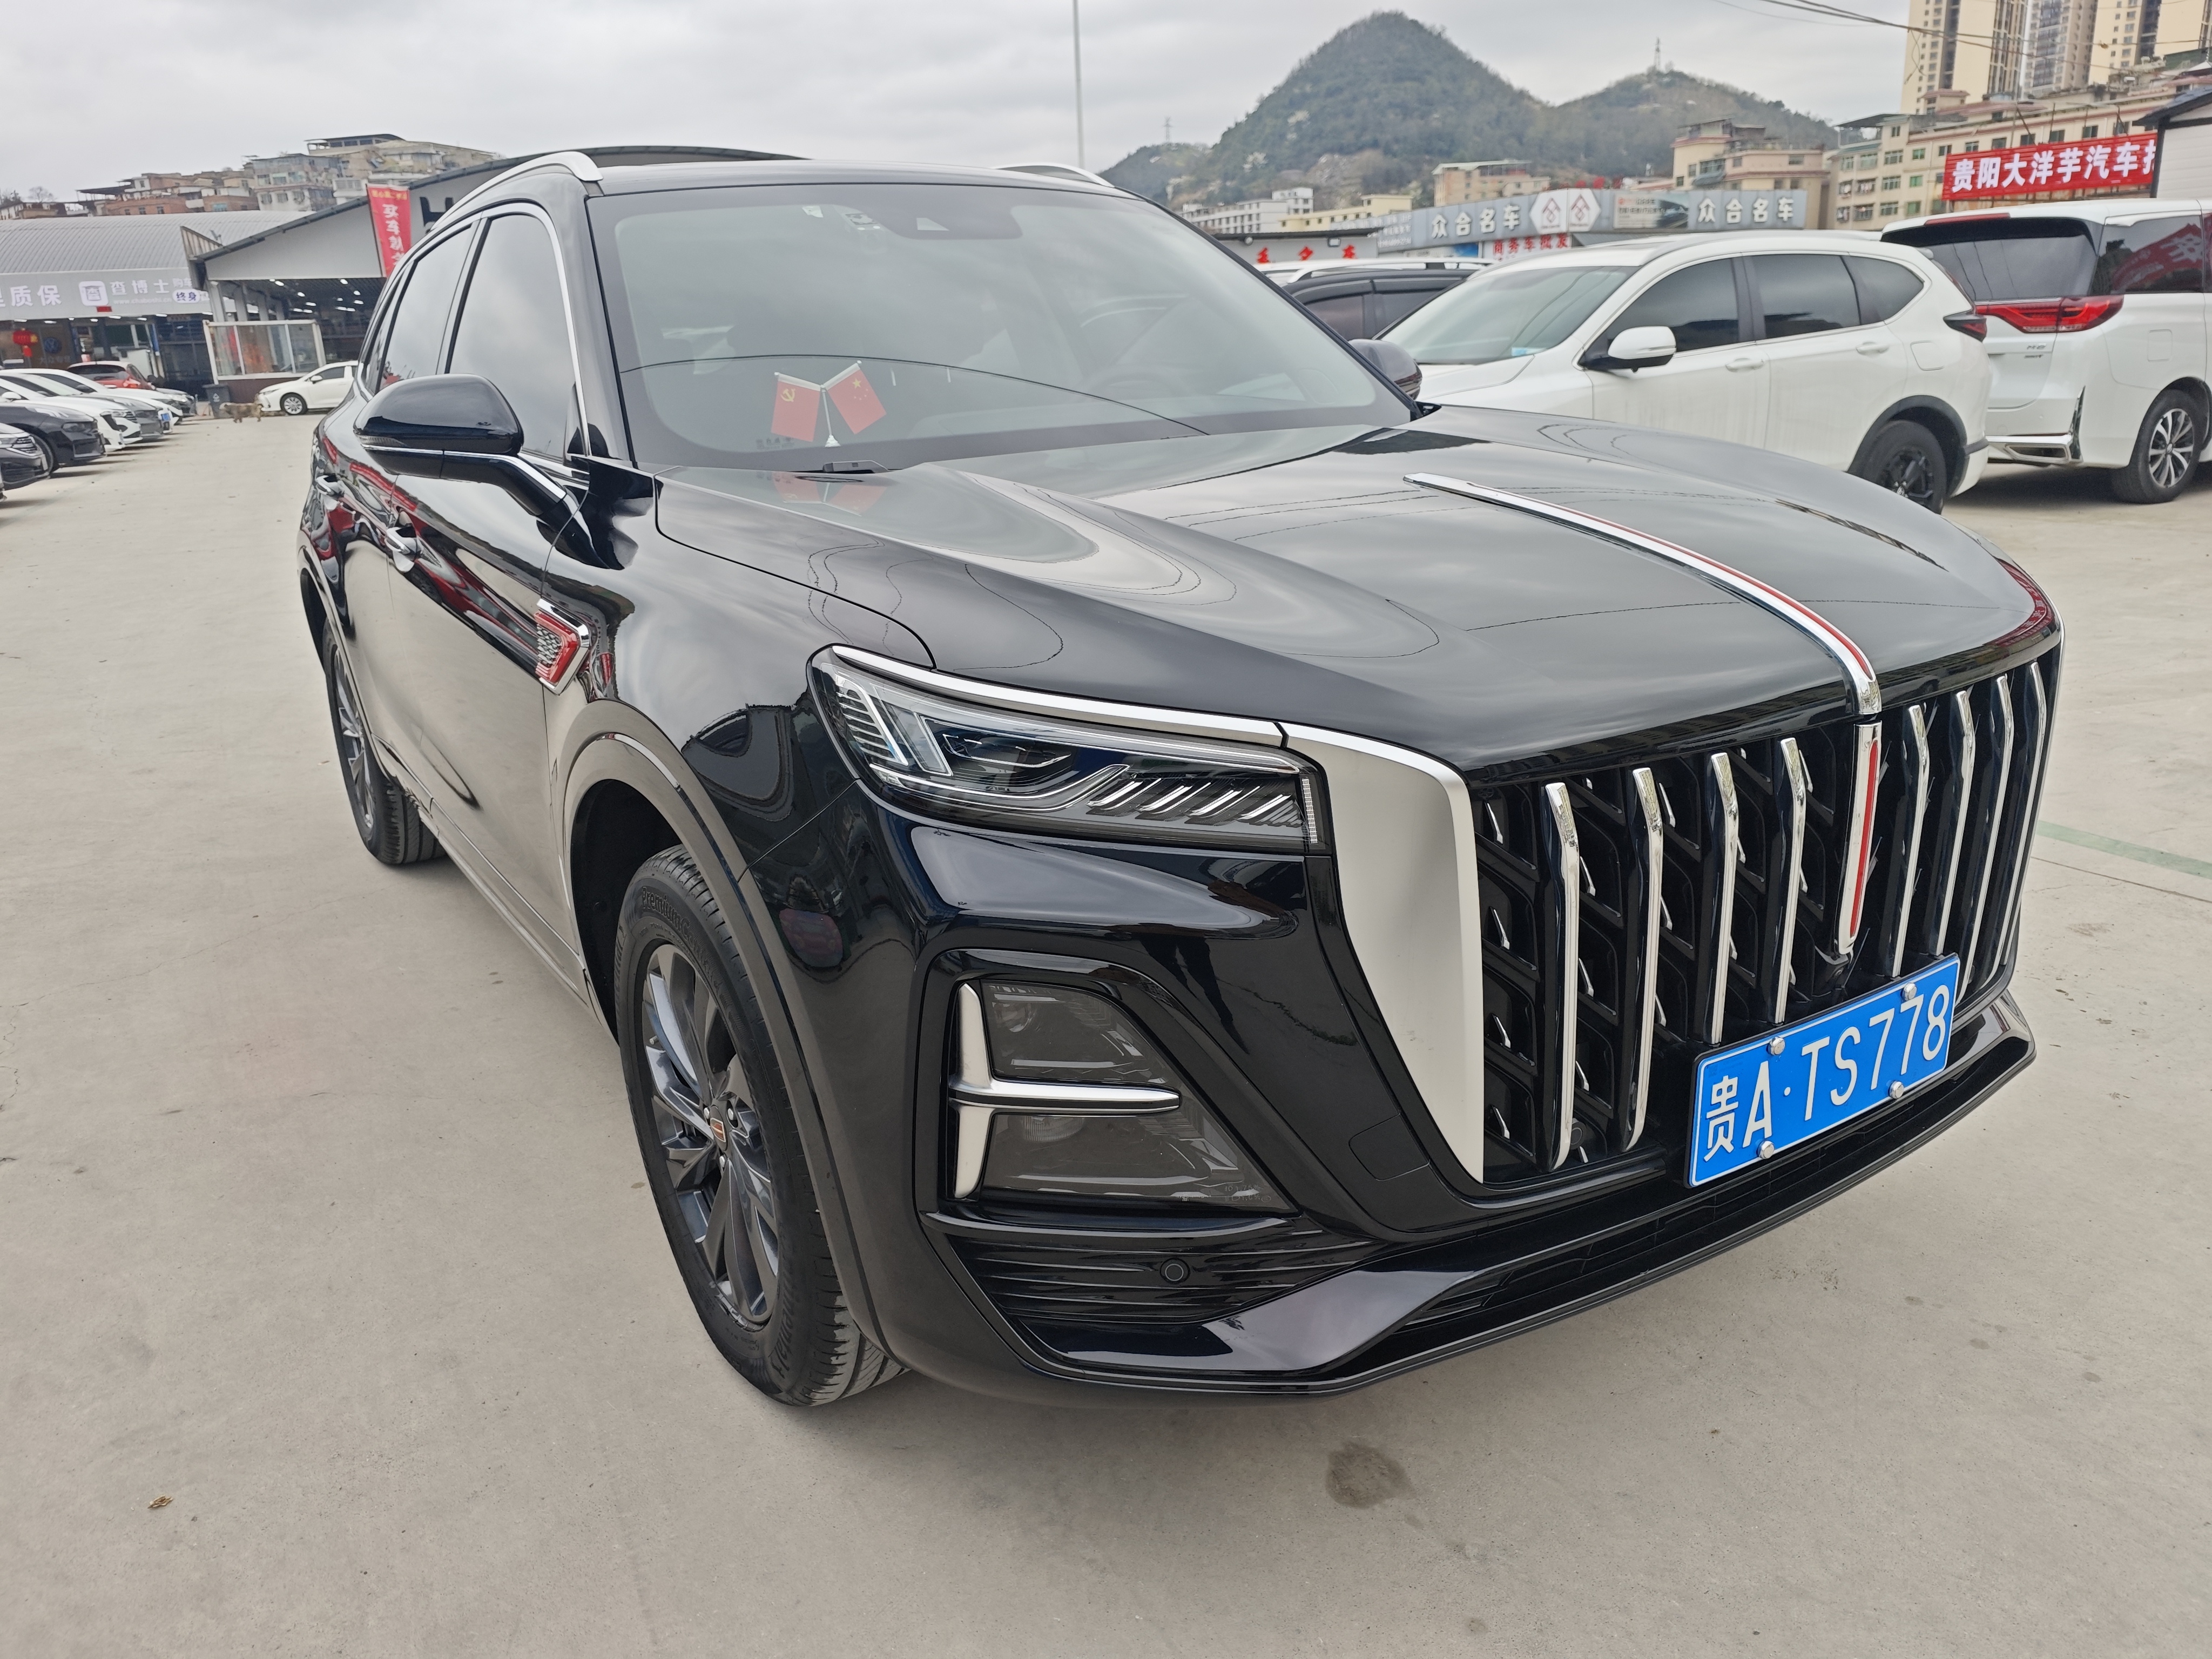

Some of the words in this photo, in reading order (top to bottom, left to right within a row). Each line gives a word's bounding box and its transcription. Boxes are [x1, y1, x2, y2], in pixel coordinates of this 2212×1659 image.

[1432, 204, 1520, 239] 众合名车
[1697, 196, 1794, 224] 众合名车
[110, 279, 170, 295] 查博士
[1704, 984, 1950, 1162] 贵A·TS778
